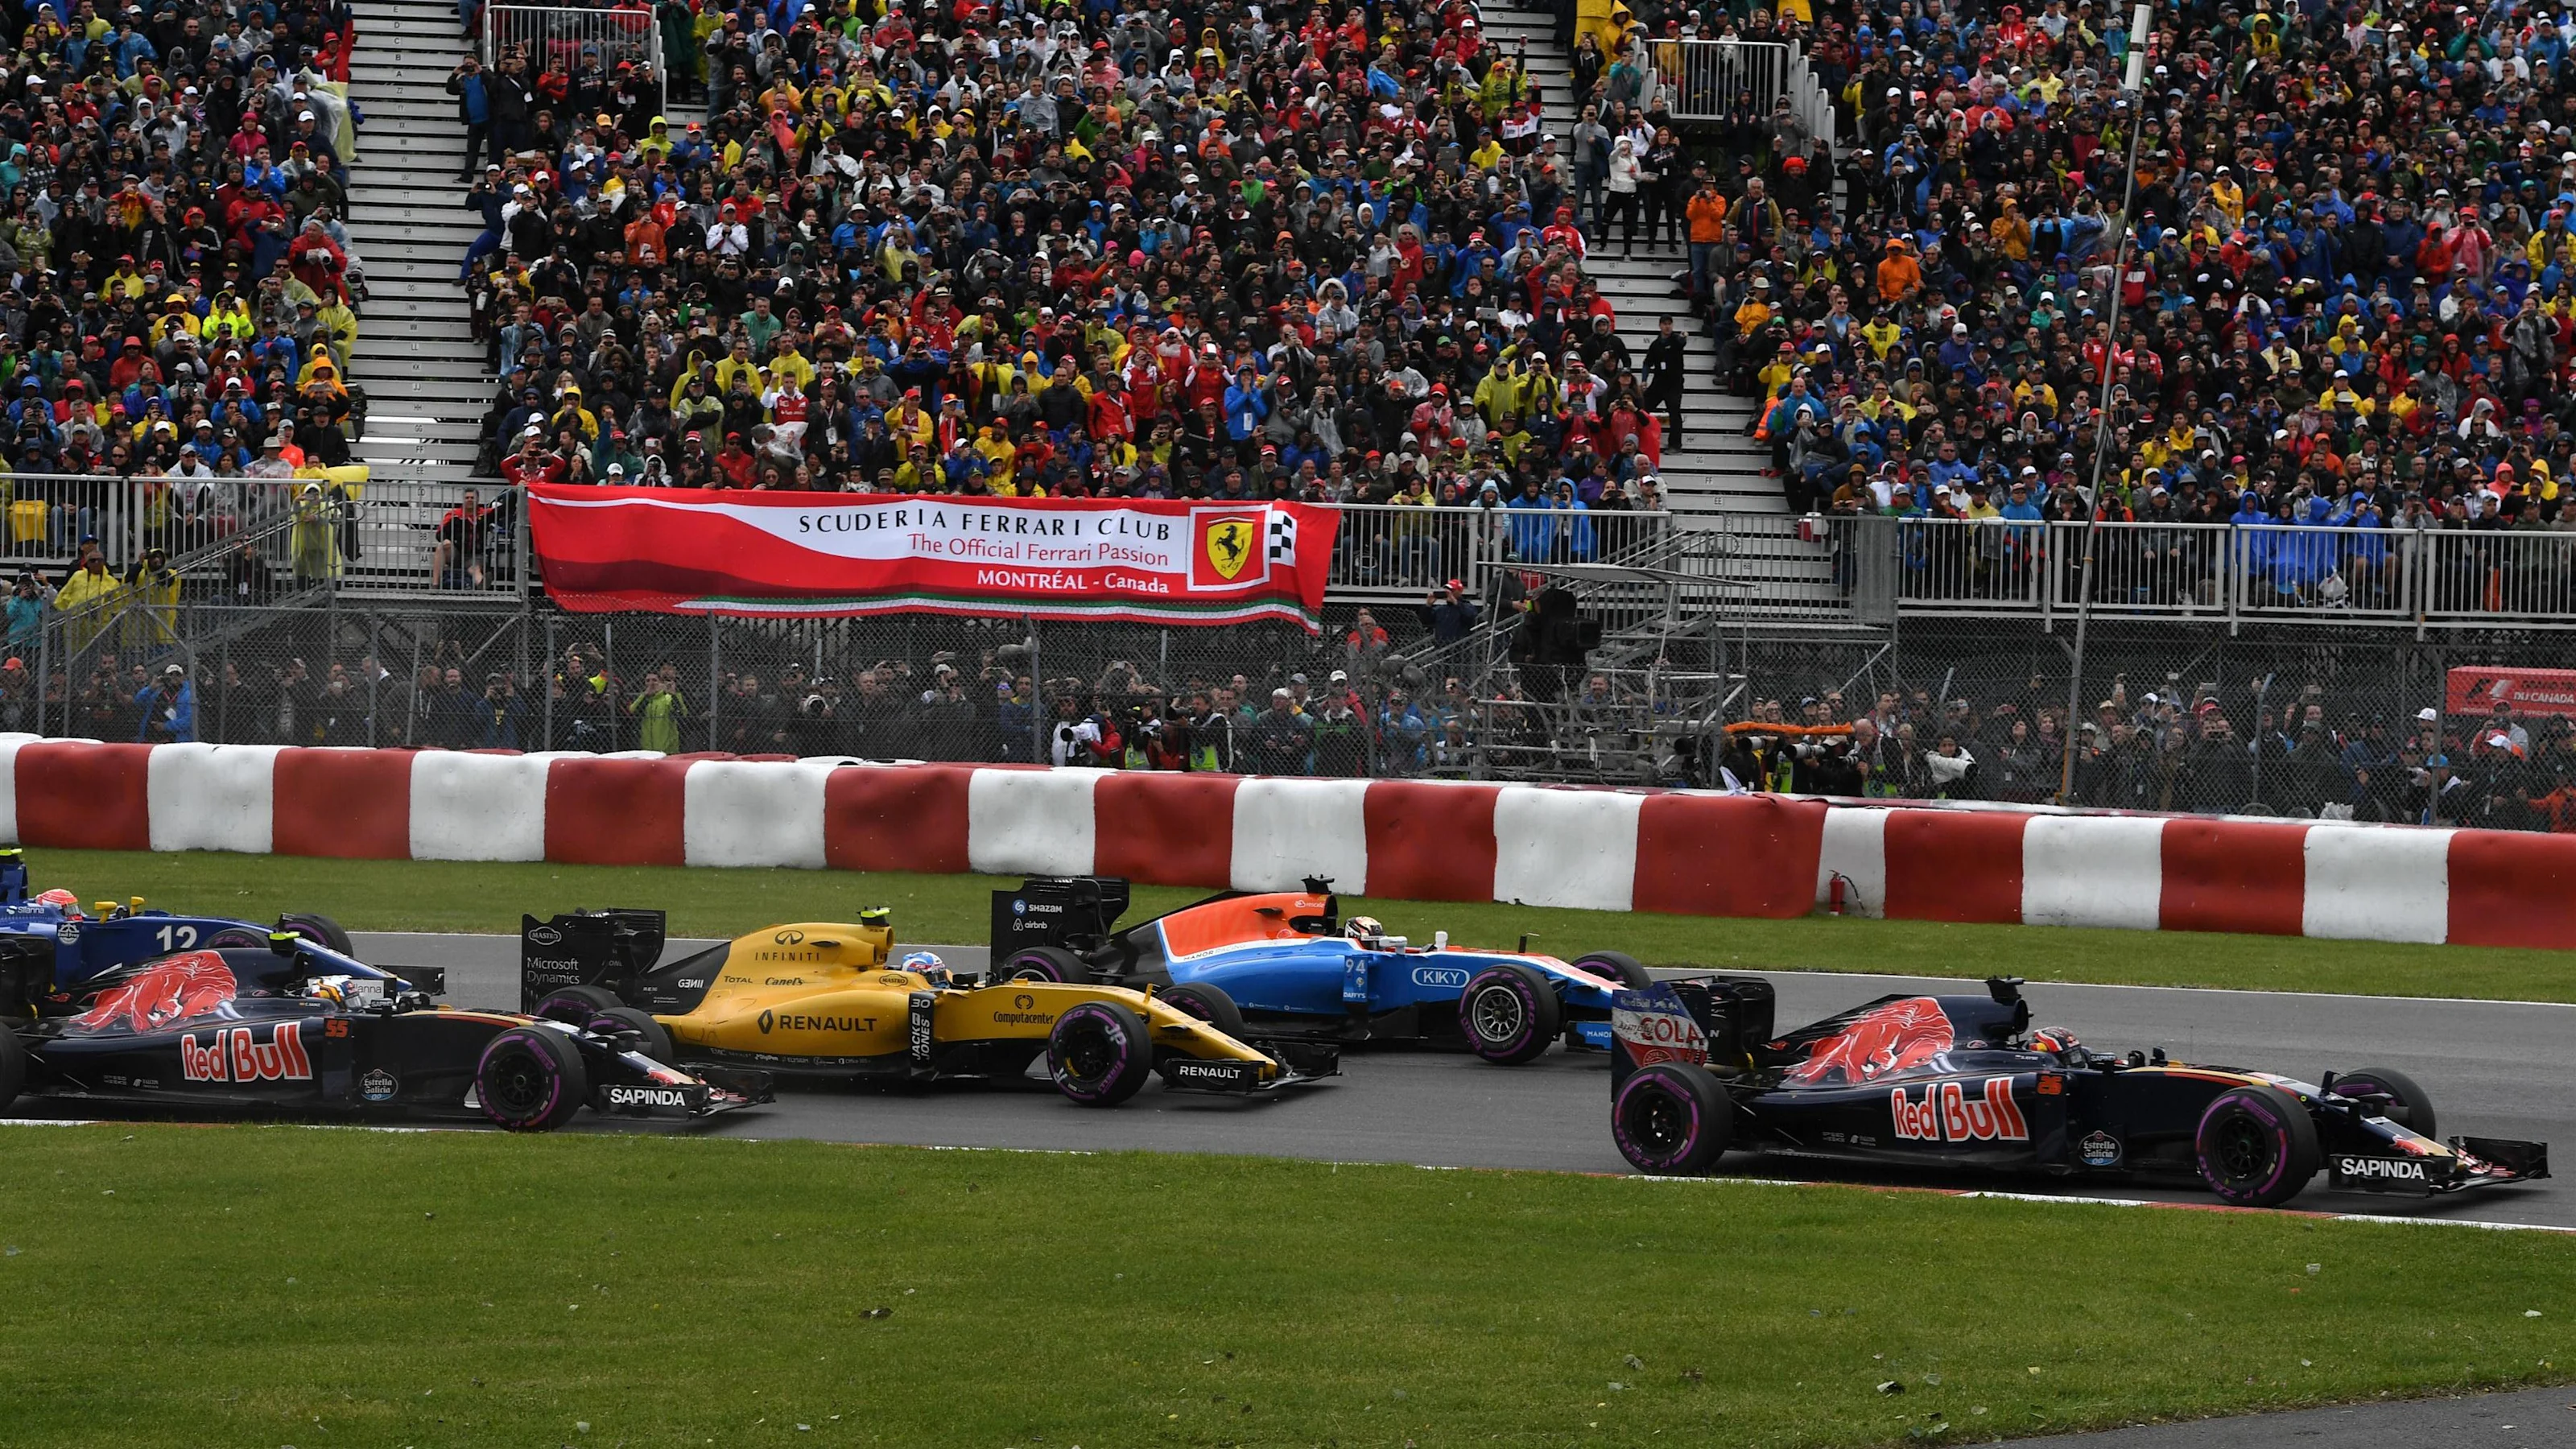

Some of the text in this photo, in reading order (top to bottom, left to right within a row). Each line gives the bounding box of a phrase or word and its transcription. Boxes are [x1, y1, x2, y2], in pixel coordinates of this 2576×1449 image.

[799, 509, 1170, 541] SCUDERIA FERRARI CLUB
[907, 533, 1169, 566] The Official Ferrari Passion
[976, 568, 1088, 589] MONTRÉAL
[1104, 573, 1170, 594] Canada
[2513, 691, 2574, 704] DU CANADA
[1028, 904, 1063, 913] SHAZAM
[1024, 920, 1047, 930] airbnb
[156, 926, 197, 952] 12
[531, 932, 559, 940] MASTRO
[755, 952, 820, 961] INFINITI
[1183, 951, 1214, 960] MANOR
[526, 957, 579, 971] Microsoft
[1345, 959, 1366, 973] 94
[527, 971, 580, 985] Dynamics
[724, 976, 753, 984] TOTAL
[1423, 969, 1460, 985] KIKY
[780, 1015, 877, 1032] RENAULT
[993, 1011, 1054, 1026] Computacenter
[325, 1020, 349, 1038] 55
[1641, 1018, 1703, 1045] COLA
[920, 1019, 931, 1060] JONES
[181, 1021, 313, 1083] Red Bull
[1179, 1065, 1242, 1080] RENAULT
[363, 1078, 393, 1087] Estrella
[364, 1086, 391, 1094] Galicia
[2037, 1075, 2062, 1095] 26
[609, 1088, 686, 1107] SAPINDA
[1891, 1076, 2029, 1142] Red Bull
[2083, 1141, 2116, 1151] Estrella
[2083, 1150, 2113, 1160] Galicia
[2340, 1158, 2425, 1180] SAPINDA
